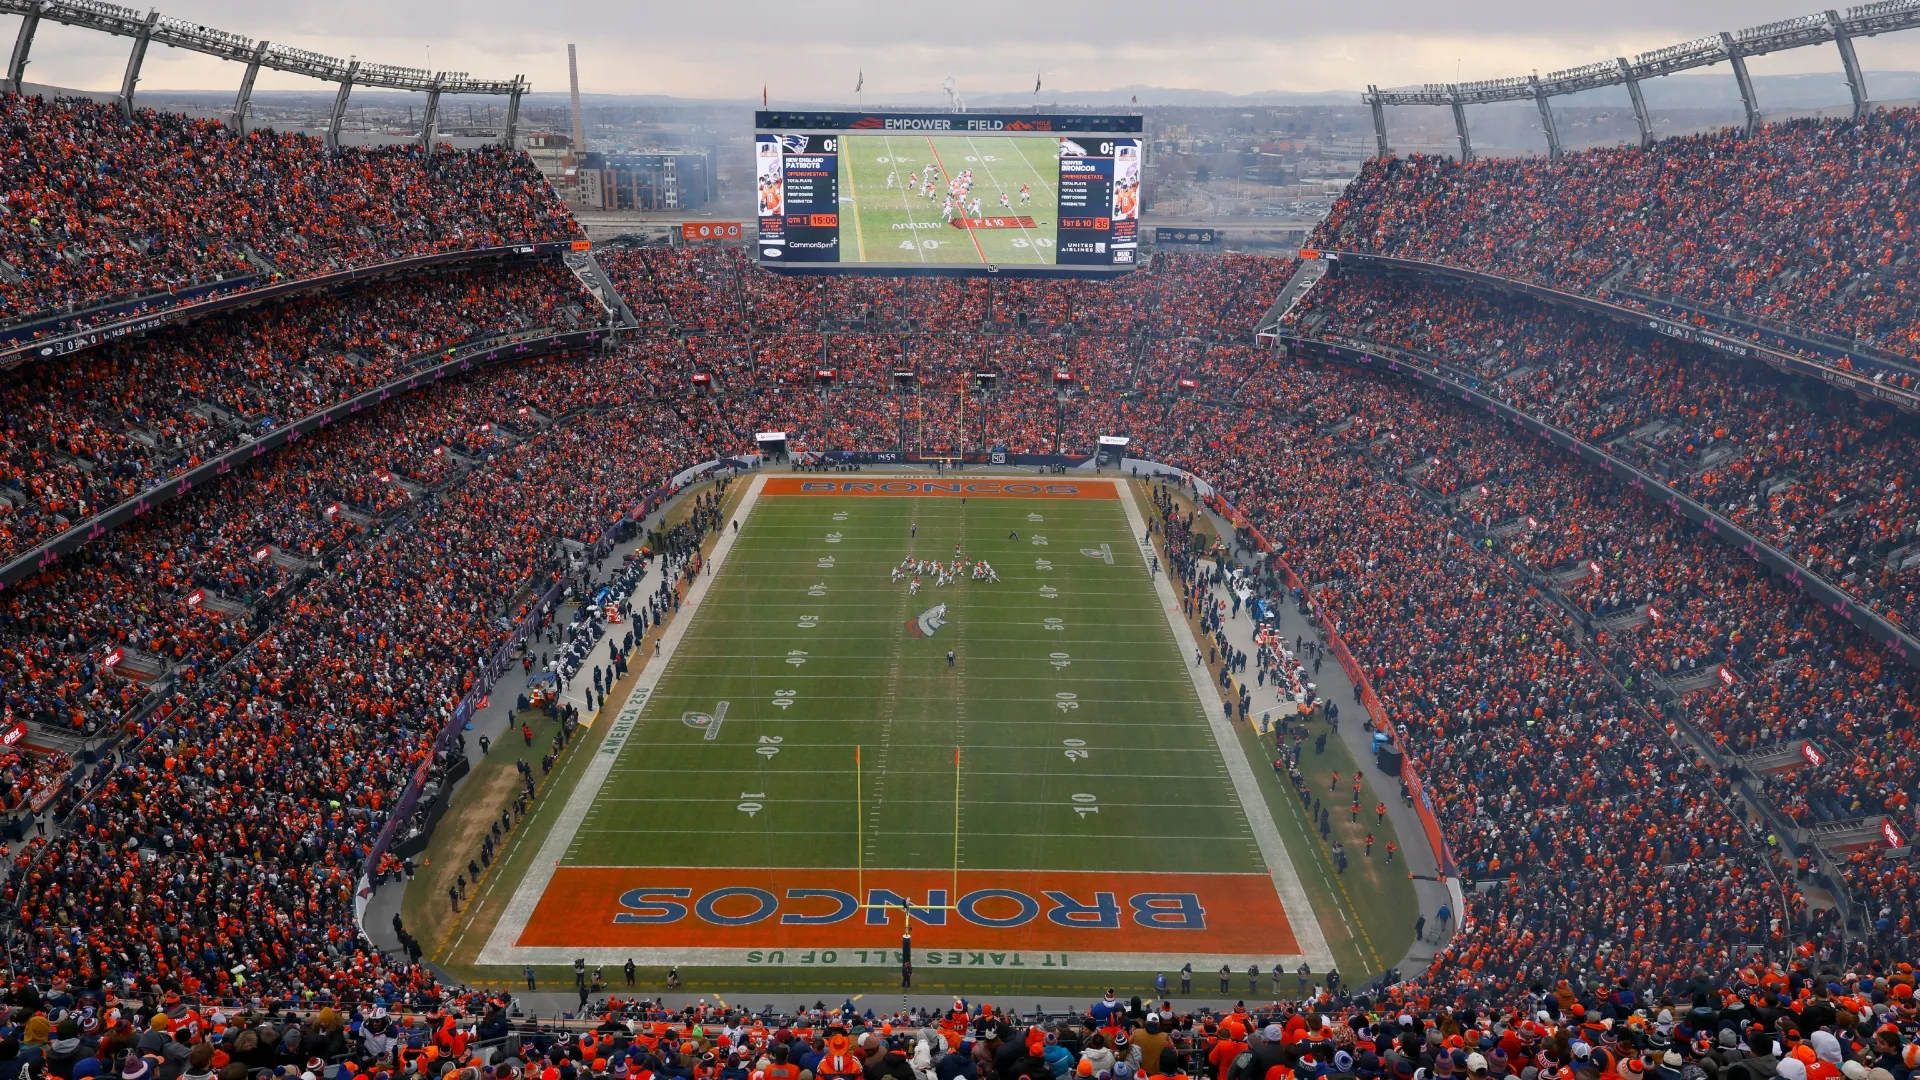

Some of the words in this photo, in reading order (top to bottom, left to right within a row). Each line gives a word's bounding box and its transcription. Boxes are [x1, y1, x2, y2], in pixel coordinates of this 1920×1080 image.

[885, 119, 950, 130] EMPOWER
[968, 120, 1003, 130] FIELD
[824, 139, 833, 151] 0
[1100, 142, 1109, 154] 0
[899, 240, 938, 250] 40
[91, 335, 96, 344] 0
[112, 328, 125, 337] 14:59
[68, 341, 73, 350] 0
[1835, 375, 1856, 388] THOMAS
[1885, 392, 1911, 406] MANNING
[800, 482, 1080, 495] BRONCOS
[798, 615, 818, 628] 50
[1044, 618, 1064, 631] 50
[786, 650, 808, 664] 40
[1050, 652, 1070, 668] 40
[482, 660, 500, 692] MILE
[501, 639, 518, 662] HIGH
[772, 690, 796, 706] 30
[1056, 692, 1078, 709] 30
[601, 708, 639, 754] AMERICA
[630, 687, 650, 705] 250
[10, 728, 19, 738] Ent
[756, 736, 782, 755] 20
[1063, 739, 1088, 758] 20
[737, 792, 765, 811] 10
[1072, 793, 1098, 813] 10
[614, 886, 1206, 930] BRONCOS
[746, 950, 784, 964] US
[800, 950, 838, 964] OF
[926, 952, 1022, 966] TAKES
[1042, 954, 1068, 966] IT
